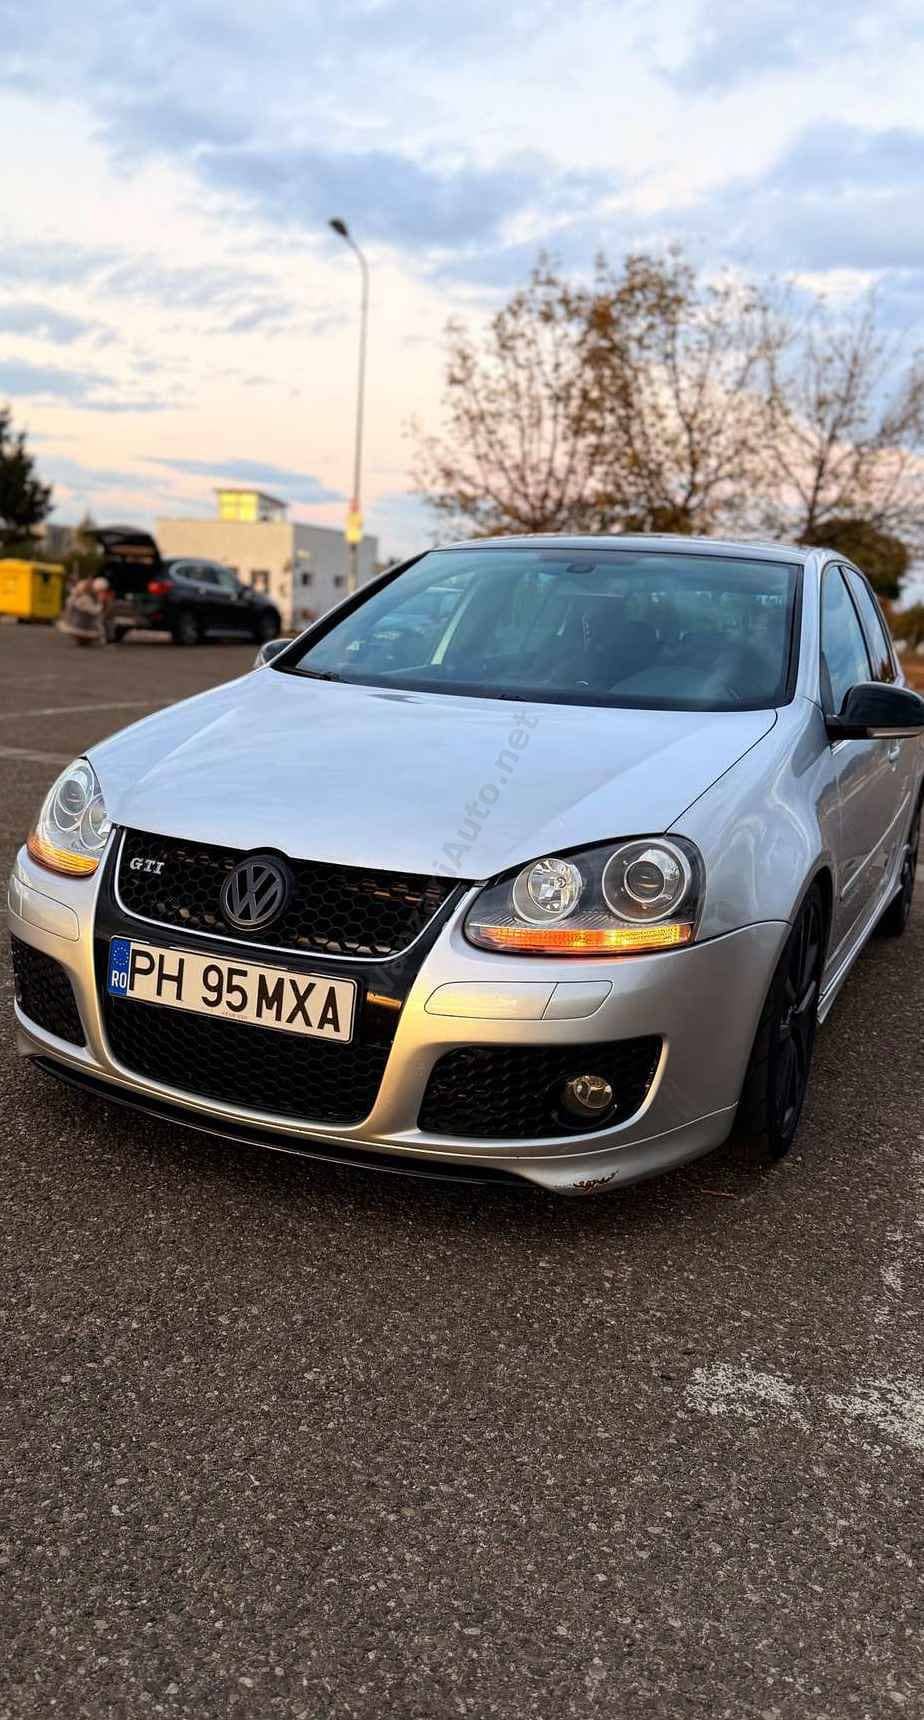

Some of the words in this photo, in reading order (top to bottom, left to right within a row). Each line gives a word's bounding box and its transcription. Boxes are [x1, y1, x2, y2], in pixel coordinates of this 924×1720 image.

[129, 857, 165, 875] GTI
[112, 970, 127, 989] RO
[129, 949, 184, 1001] PH
[201, 964, 248, 1013] 95
[255, 973, 341, 1033] MXA
